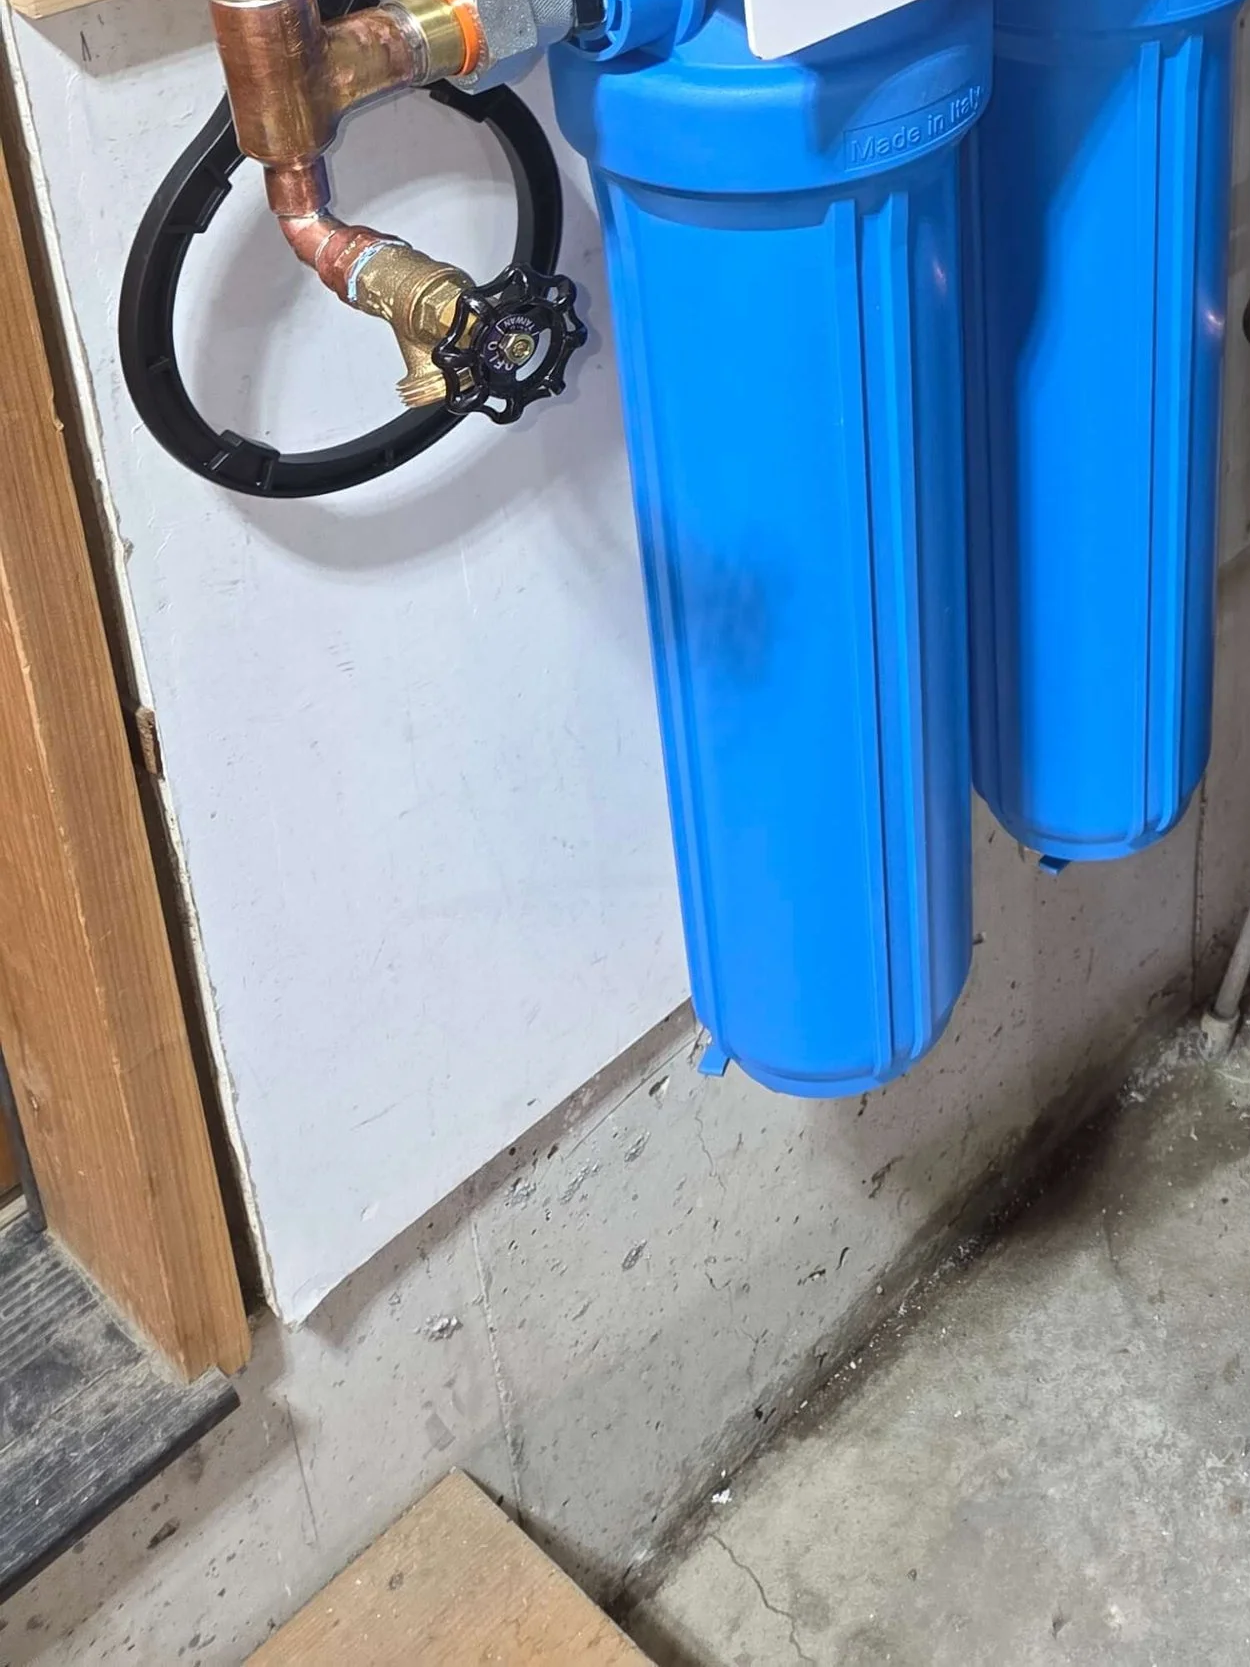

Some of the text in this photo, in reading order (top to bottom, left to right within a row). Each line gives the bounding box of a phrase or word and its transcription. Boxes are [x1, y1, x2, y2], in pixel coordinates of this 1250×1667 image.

[851, 85, 981, 164] Made in Italy
